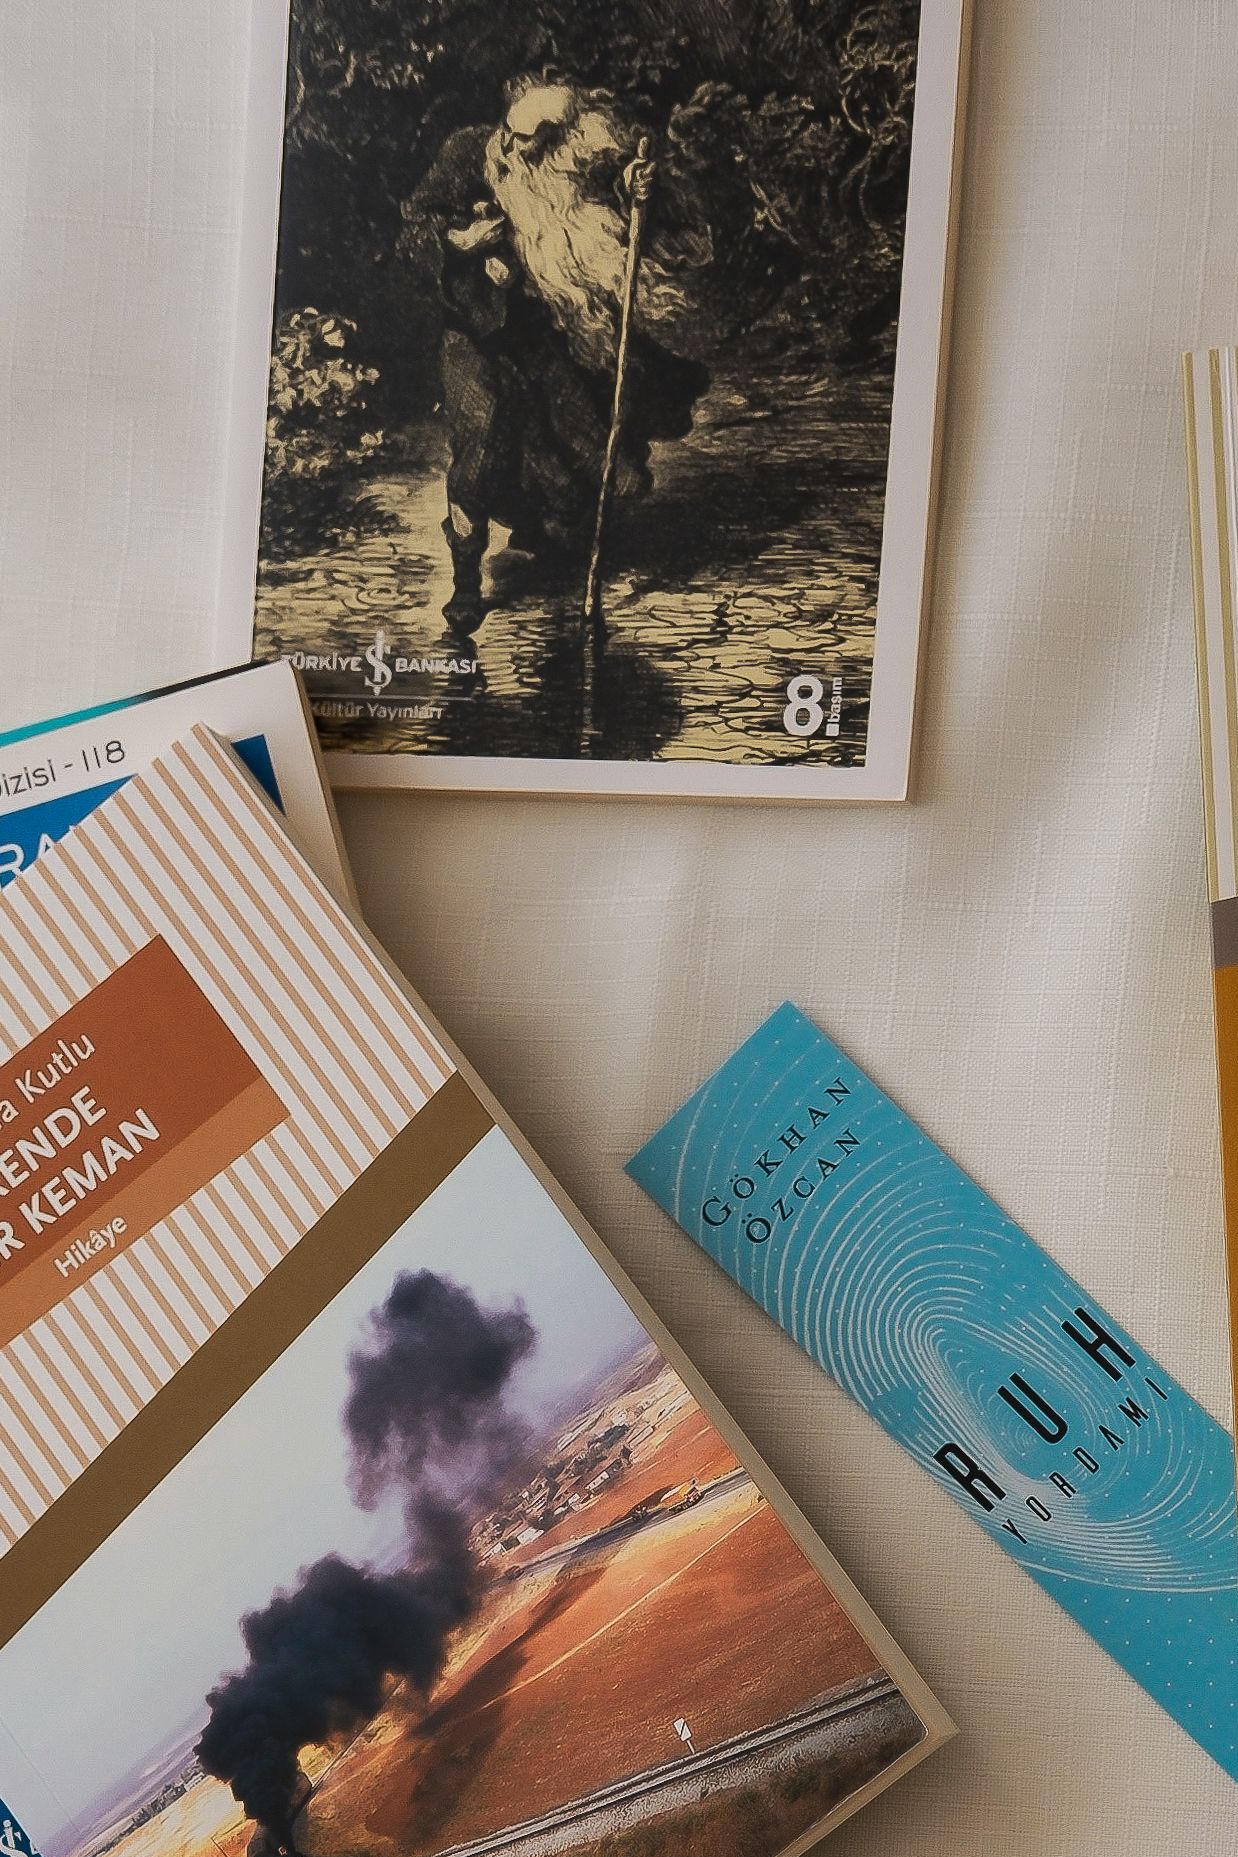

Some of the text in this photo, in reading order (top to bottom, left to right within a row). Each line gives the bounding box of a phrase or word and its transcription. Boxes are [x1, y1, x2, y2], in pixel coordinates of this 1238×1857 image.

[394, 657, 478, 675] BANKASI
[783, 674, 824, 737] 8
[0, 758, 57, 797] izisi
[14, 1034, 97, 1103] Kutlu
[0, 1086, 107, 1198] ENDE
[19, 1108, 161, 1235] KEMAN
[702, 1076, 852, 1227] GÖKHAN
[741, 1128, 861, 1244] ÖZCAN
[53, 1216, 129, 1278] Hikâye
[932, 1306, 1136, 1513] RUH
